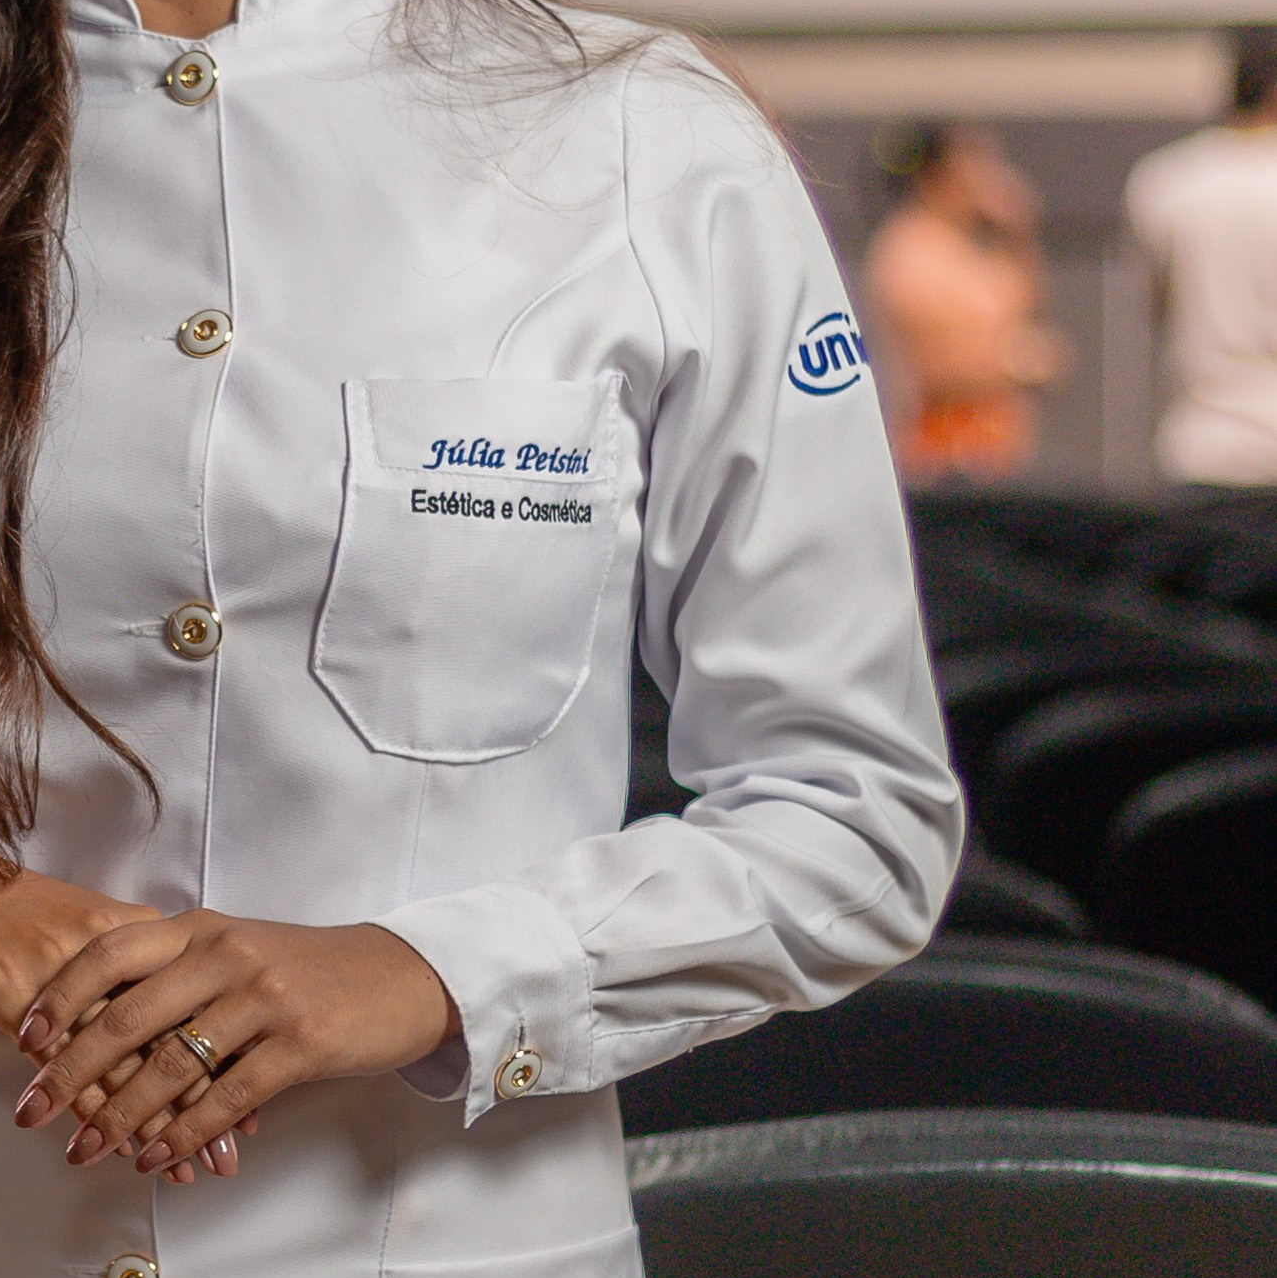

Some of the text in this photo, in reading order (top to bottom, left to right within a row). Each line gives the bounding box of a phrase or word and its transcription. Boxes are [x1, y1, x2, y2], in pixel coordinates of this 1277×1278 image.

[422, 437, 505, 469] Júlia
[411, 488, 593, 525] Estética e Cosmética
